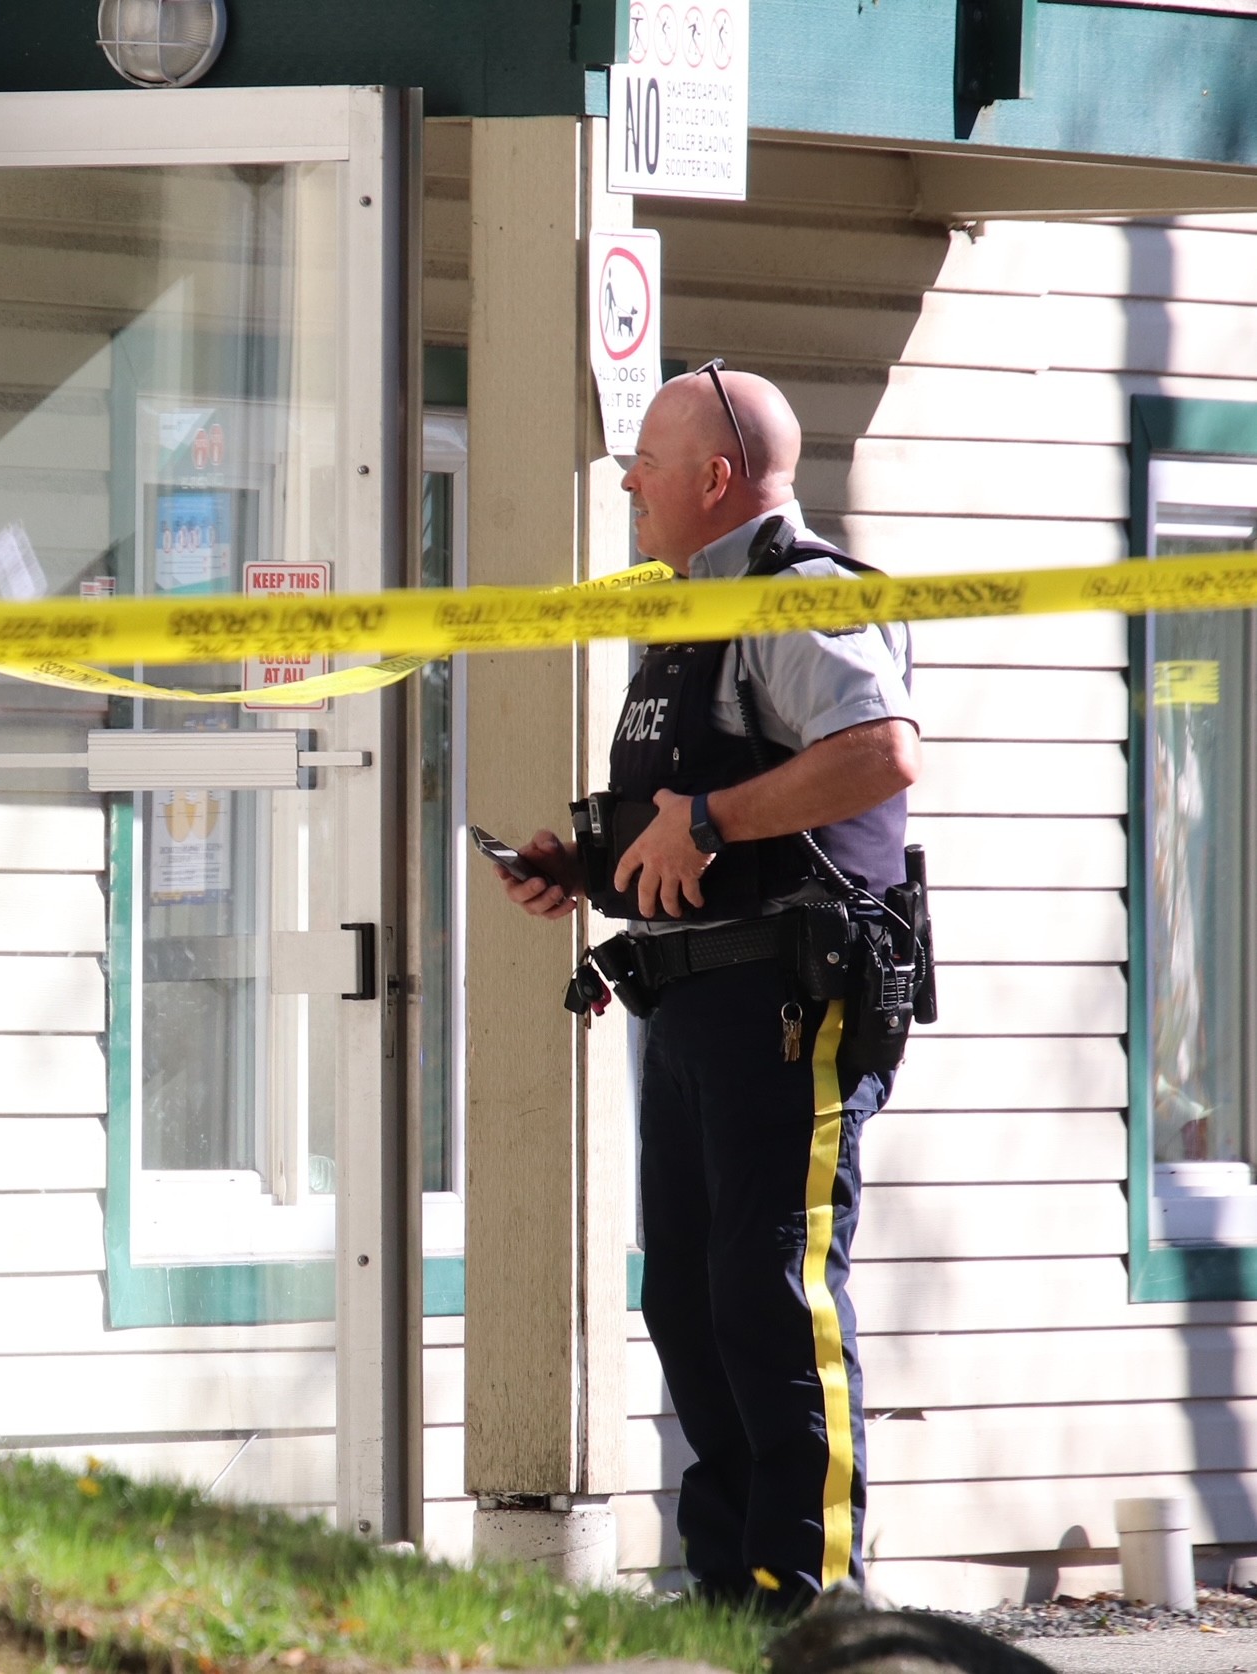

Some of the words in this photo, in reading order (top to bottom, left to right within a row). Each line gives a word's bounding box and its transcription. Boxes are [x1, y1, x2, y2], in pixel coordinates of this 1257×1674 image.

[667, 80, 733, 102] SKATEBOARDING
[625, 76, 660, 175] NO
[666, 132, 695, 151] ROLLER
[612, 366, 646, 383] DOGS
[626, 392, 642, 408] BE
[612, 418, 644, 434] LEAS
[252, 572, 285, 589] KEEP
[288, 572, 320, 589] THIS
[755, 584, 885, 615] INTERDIT
[890, 577, 1023, 607] PASSAGE
[169, 608, 271, 638] CROSS
[276, 606, 335, 635] NOT
[338, 604, 386, 635] DO
[264, 667, 280, 684] AT
